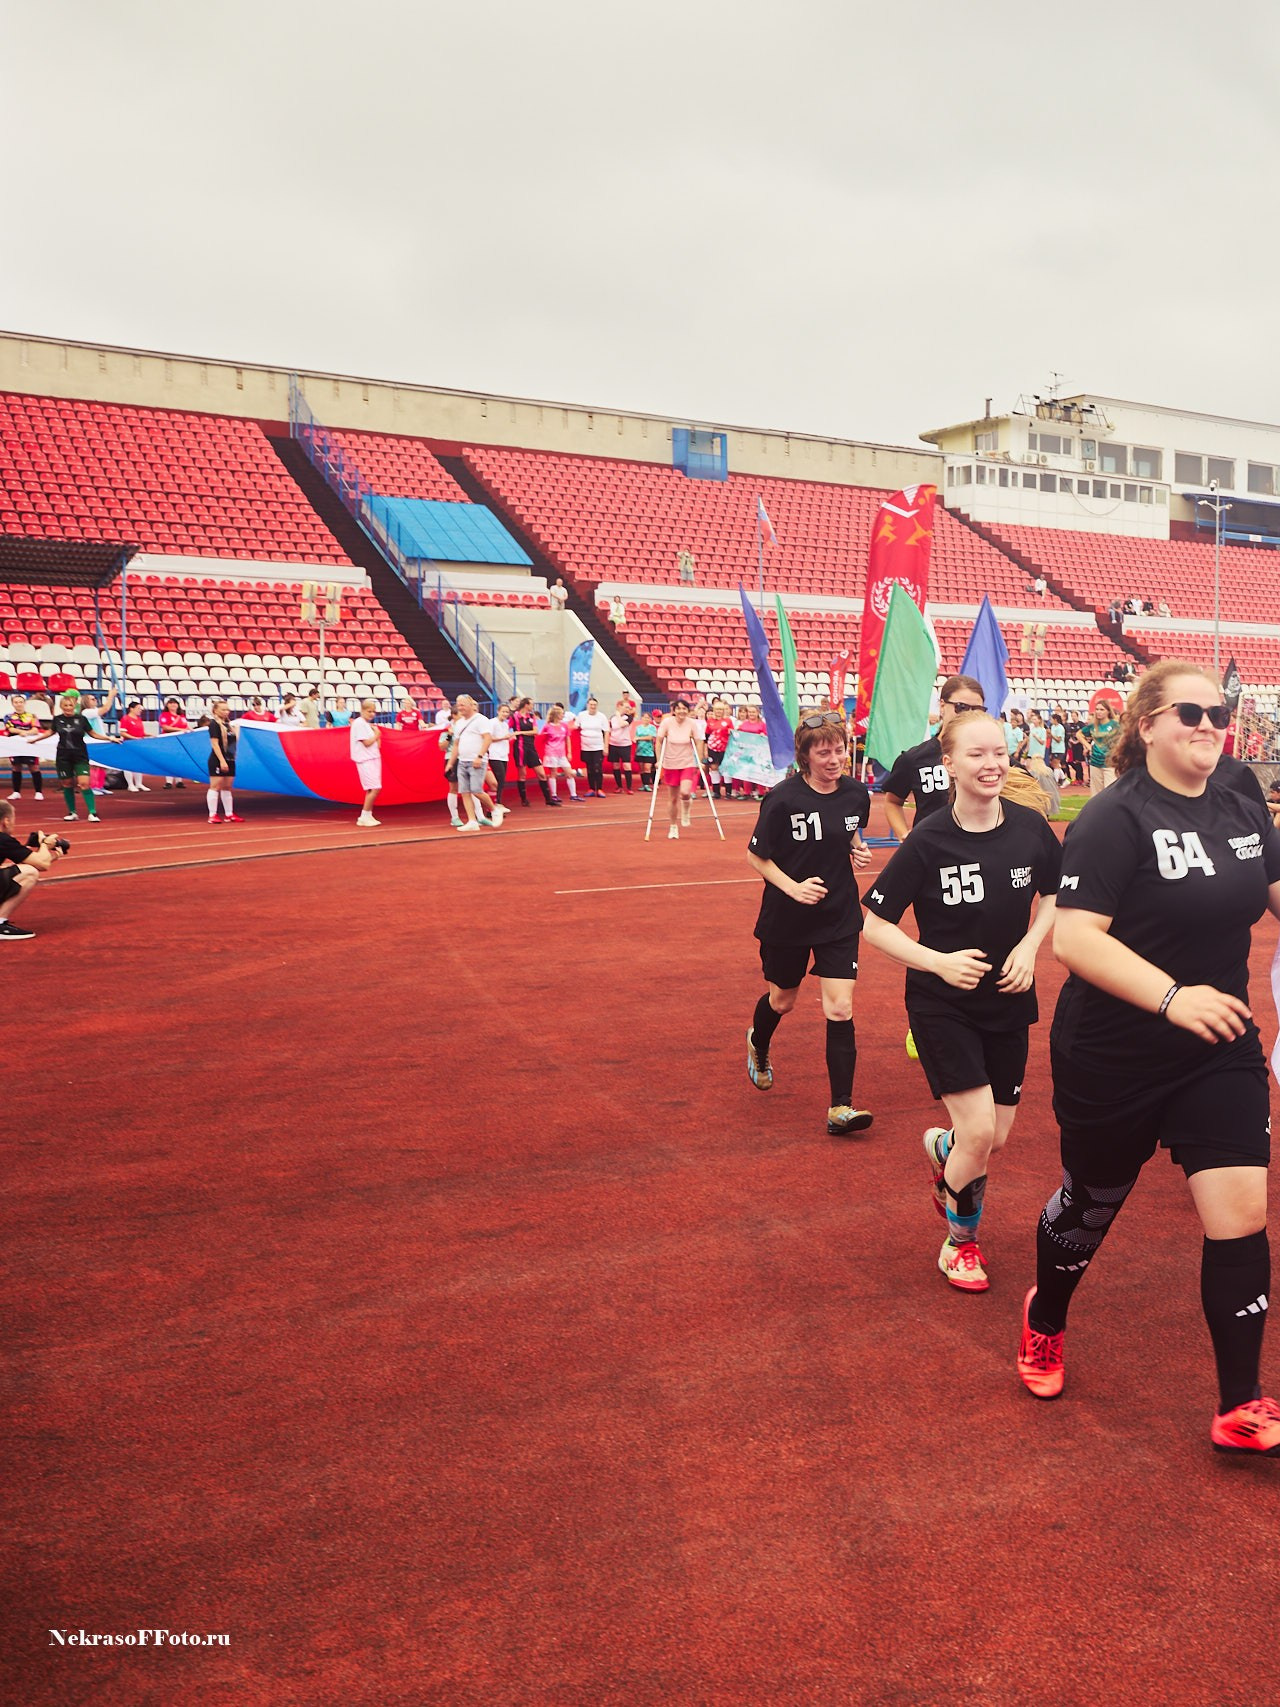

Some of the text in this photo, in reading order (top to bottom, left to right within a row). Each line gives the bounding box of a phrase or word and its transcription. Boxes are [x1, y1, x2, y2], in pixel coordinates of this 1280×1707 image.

[919, 765, 950, 793] 59
[790, 812, 823, 841] 51
[1152, 829, 1217, 880] 64
[939, 863, 985, 906] 55
